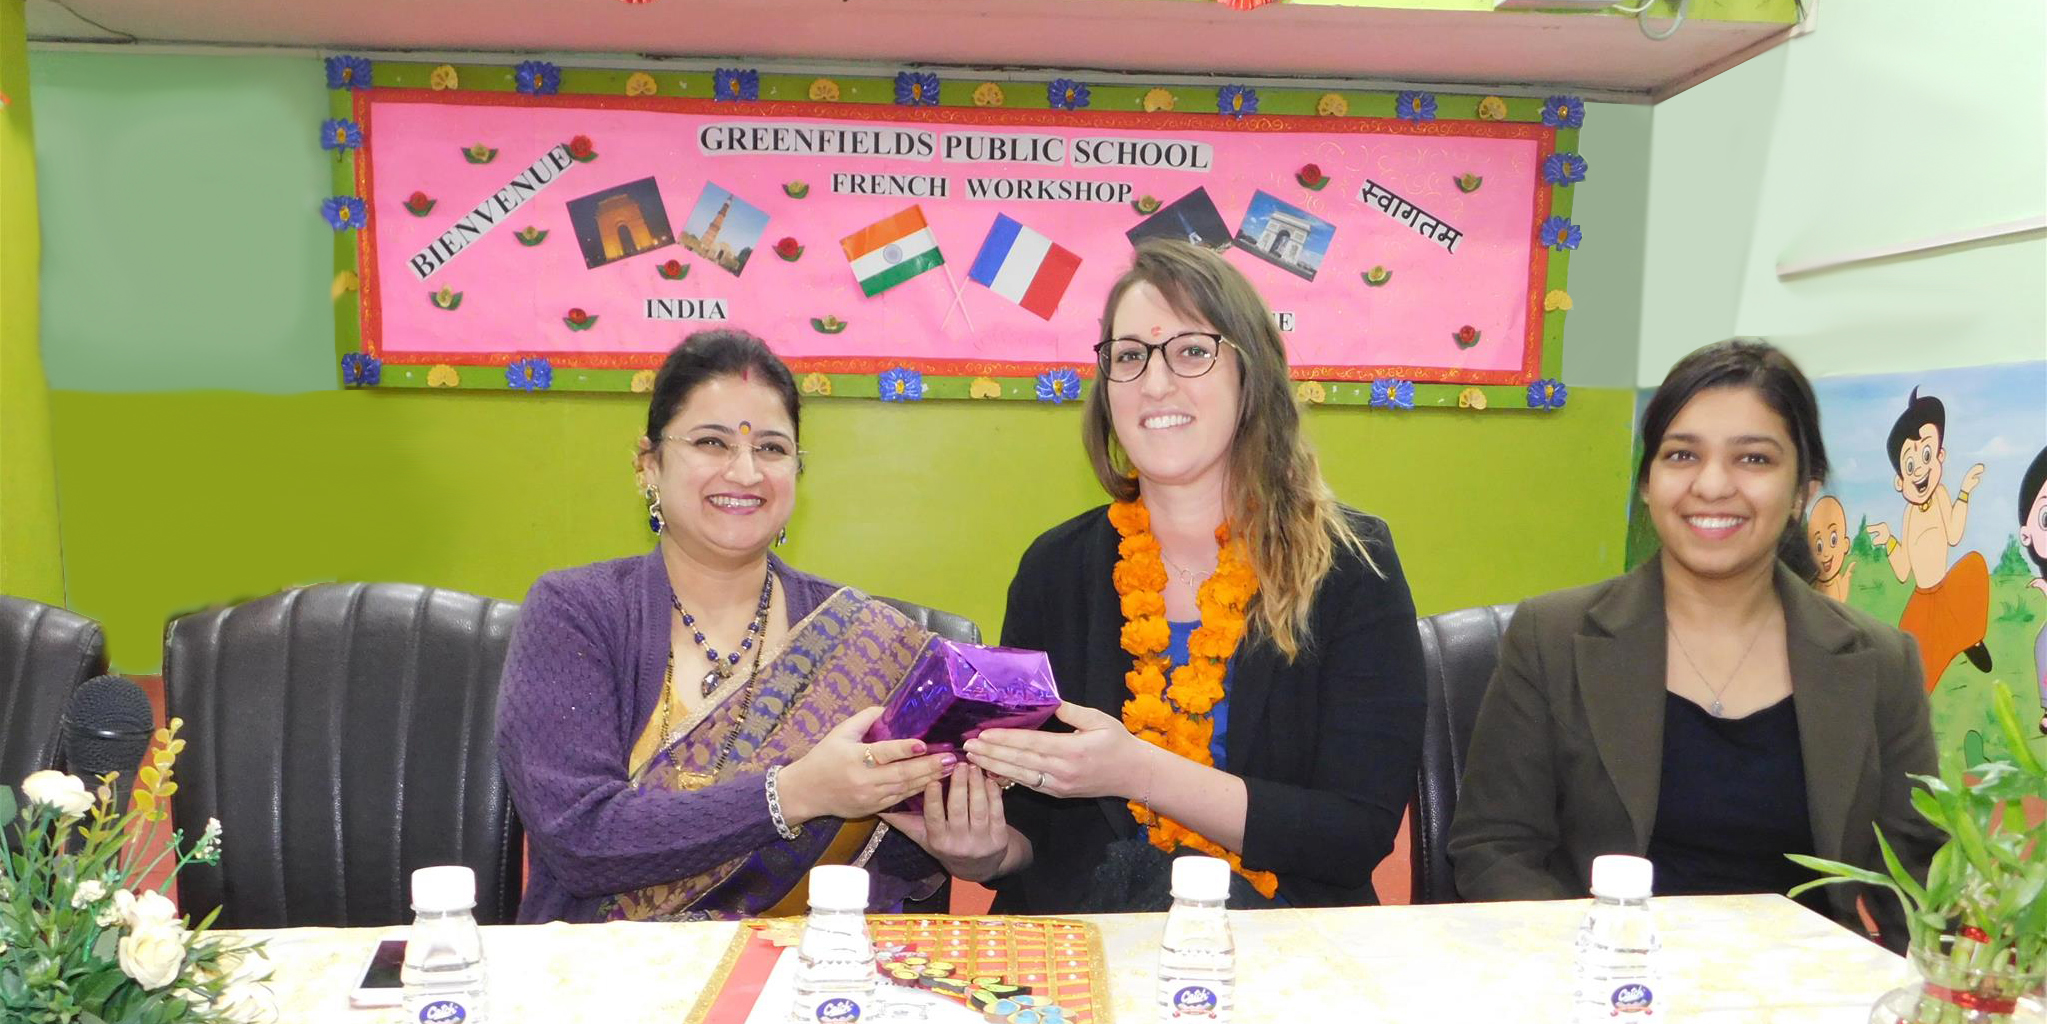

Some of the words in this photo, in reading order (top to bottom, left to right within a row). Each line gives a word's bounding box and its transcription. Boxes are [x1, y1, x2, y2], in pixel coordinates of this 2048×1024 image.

[700, 125, 934, 156] GREENFIELDS
[944, 135, 1064, 162] PUBLIC
[1073, 138, 1210, 169] SCHOOL
[832, 173, 948, 197] FRENCH
[966, 178, 1133, 203] WORKSHOP
[410, 143, 573, 278] BIENVENUE
[1362, 178, 1464, 255] स्वागतम्
[645, 298, 727, 320] INDIA
[1180, 988, 1209, 1004] Catch
[1618, 985, 1645, 1003] Catch
